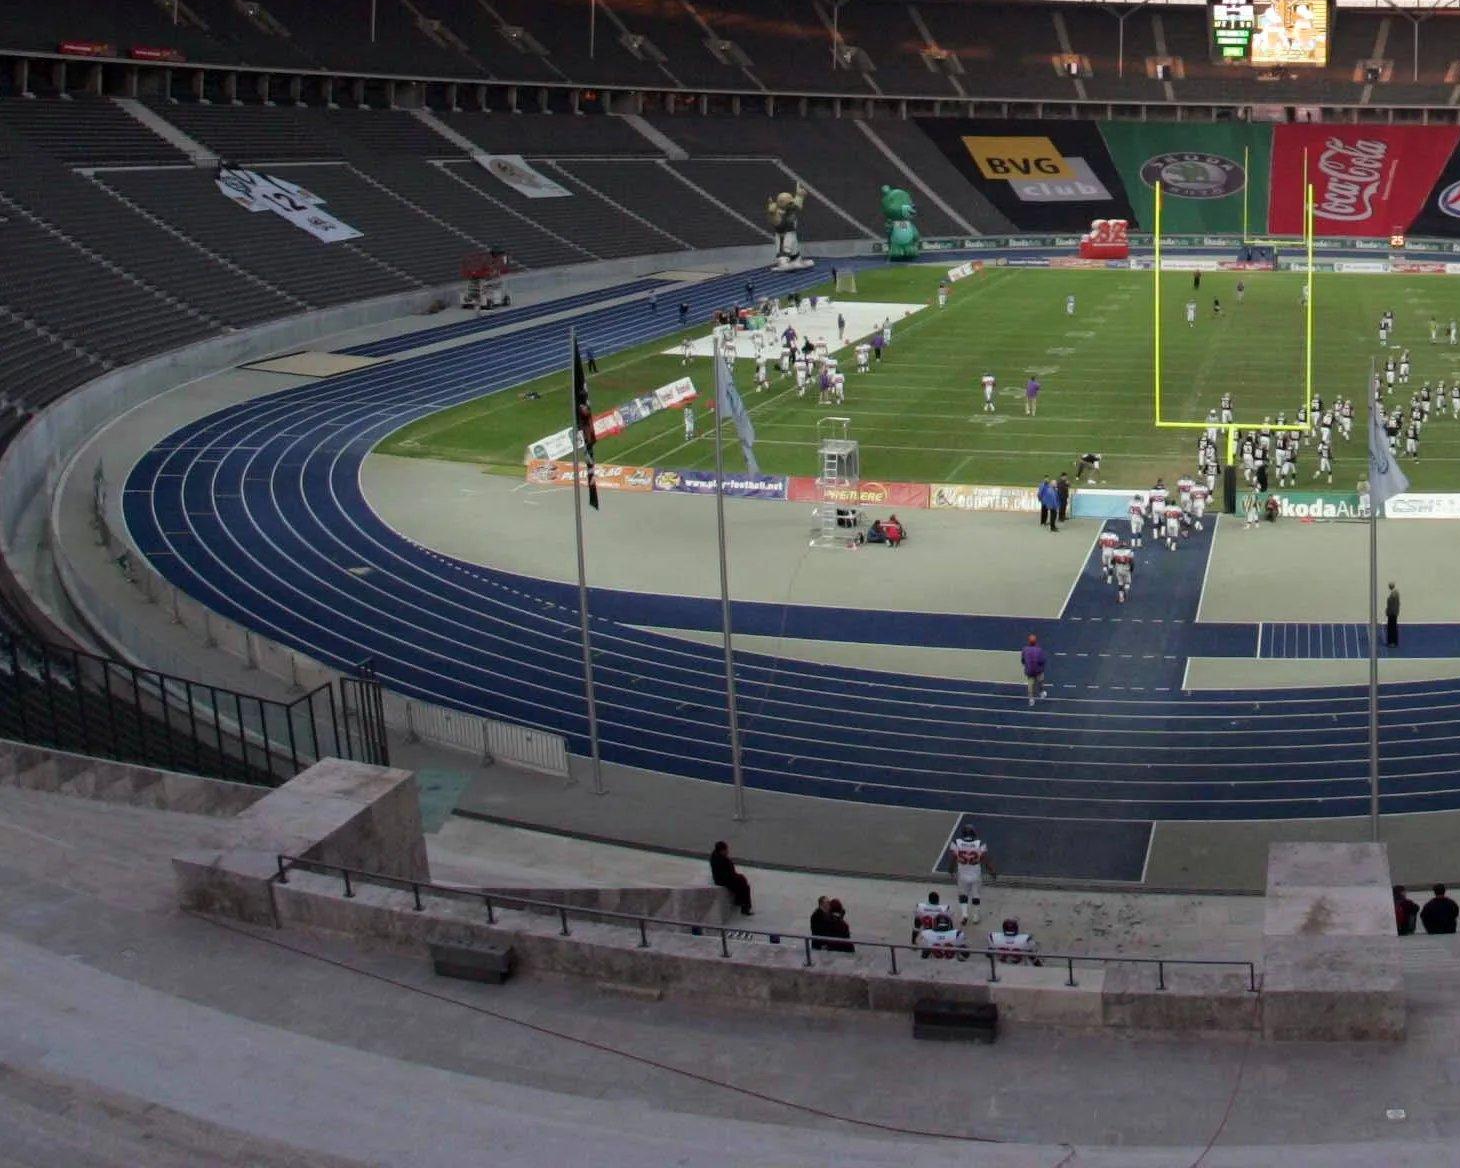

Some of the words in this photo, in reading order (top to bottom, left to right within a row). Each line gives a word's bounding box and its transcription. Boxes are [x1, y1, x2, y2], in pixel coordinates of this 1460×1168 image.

[985, 157, 1061, 176] BVG
[1305, 137, 1388, 221] Coca-Cola
[1022, 181, 1099, 196] club
[261, 192, 309, 213] 12
[1390, 235, 1404, 246] 25
[684, 479, 783, 492] www.ply-football.net
